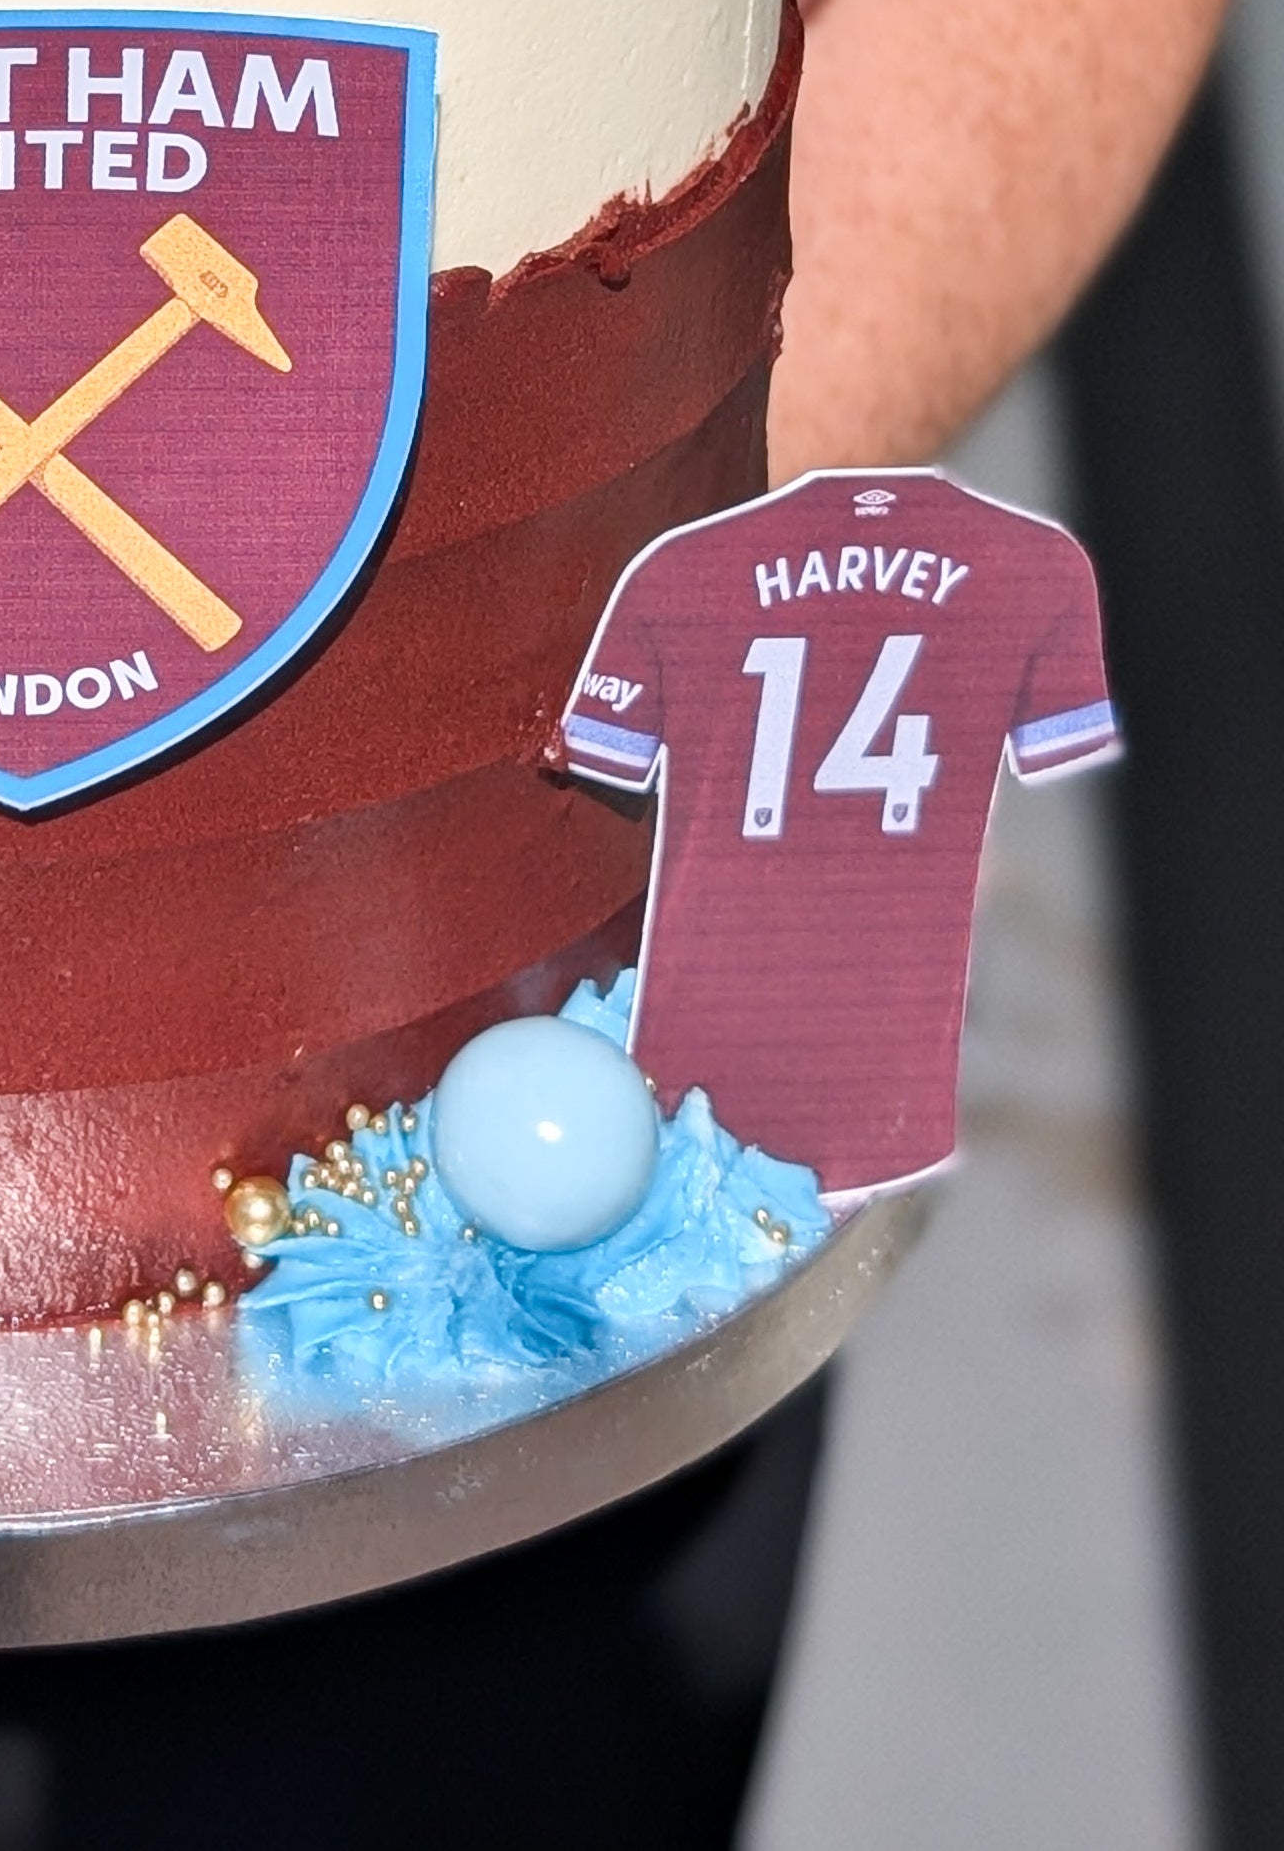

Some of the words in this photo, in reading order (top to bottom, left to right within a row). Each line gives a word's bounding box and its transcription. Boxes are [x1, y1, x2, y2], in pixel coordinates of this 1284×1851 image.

[67, 46, 340, 137] HAM
[755, 545, 969, 608] HARVEY
[742, 634, 938, 838] 14
